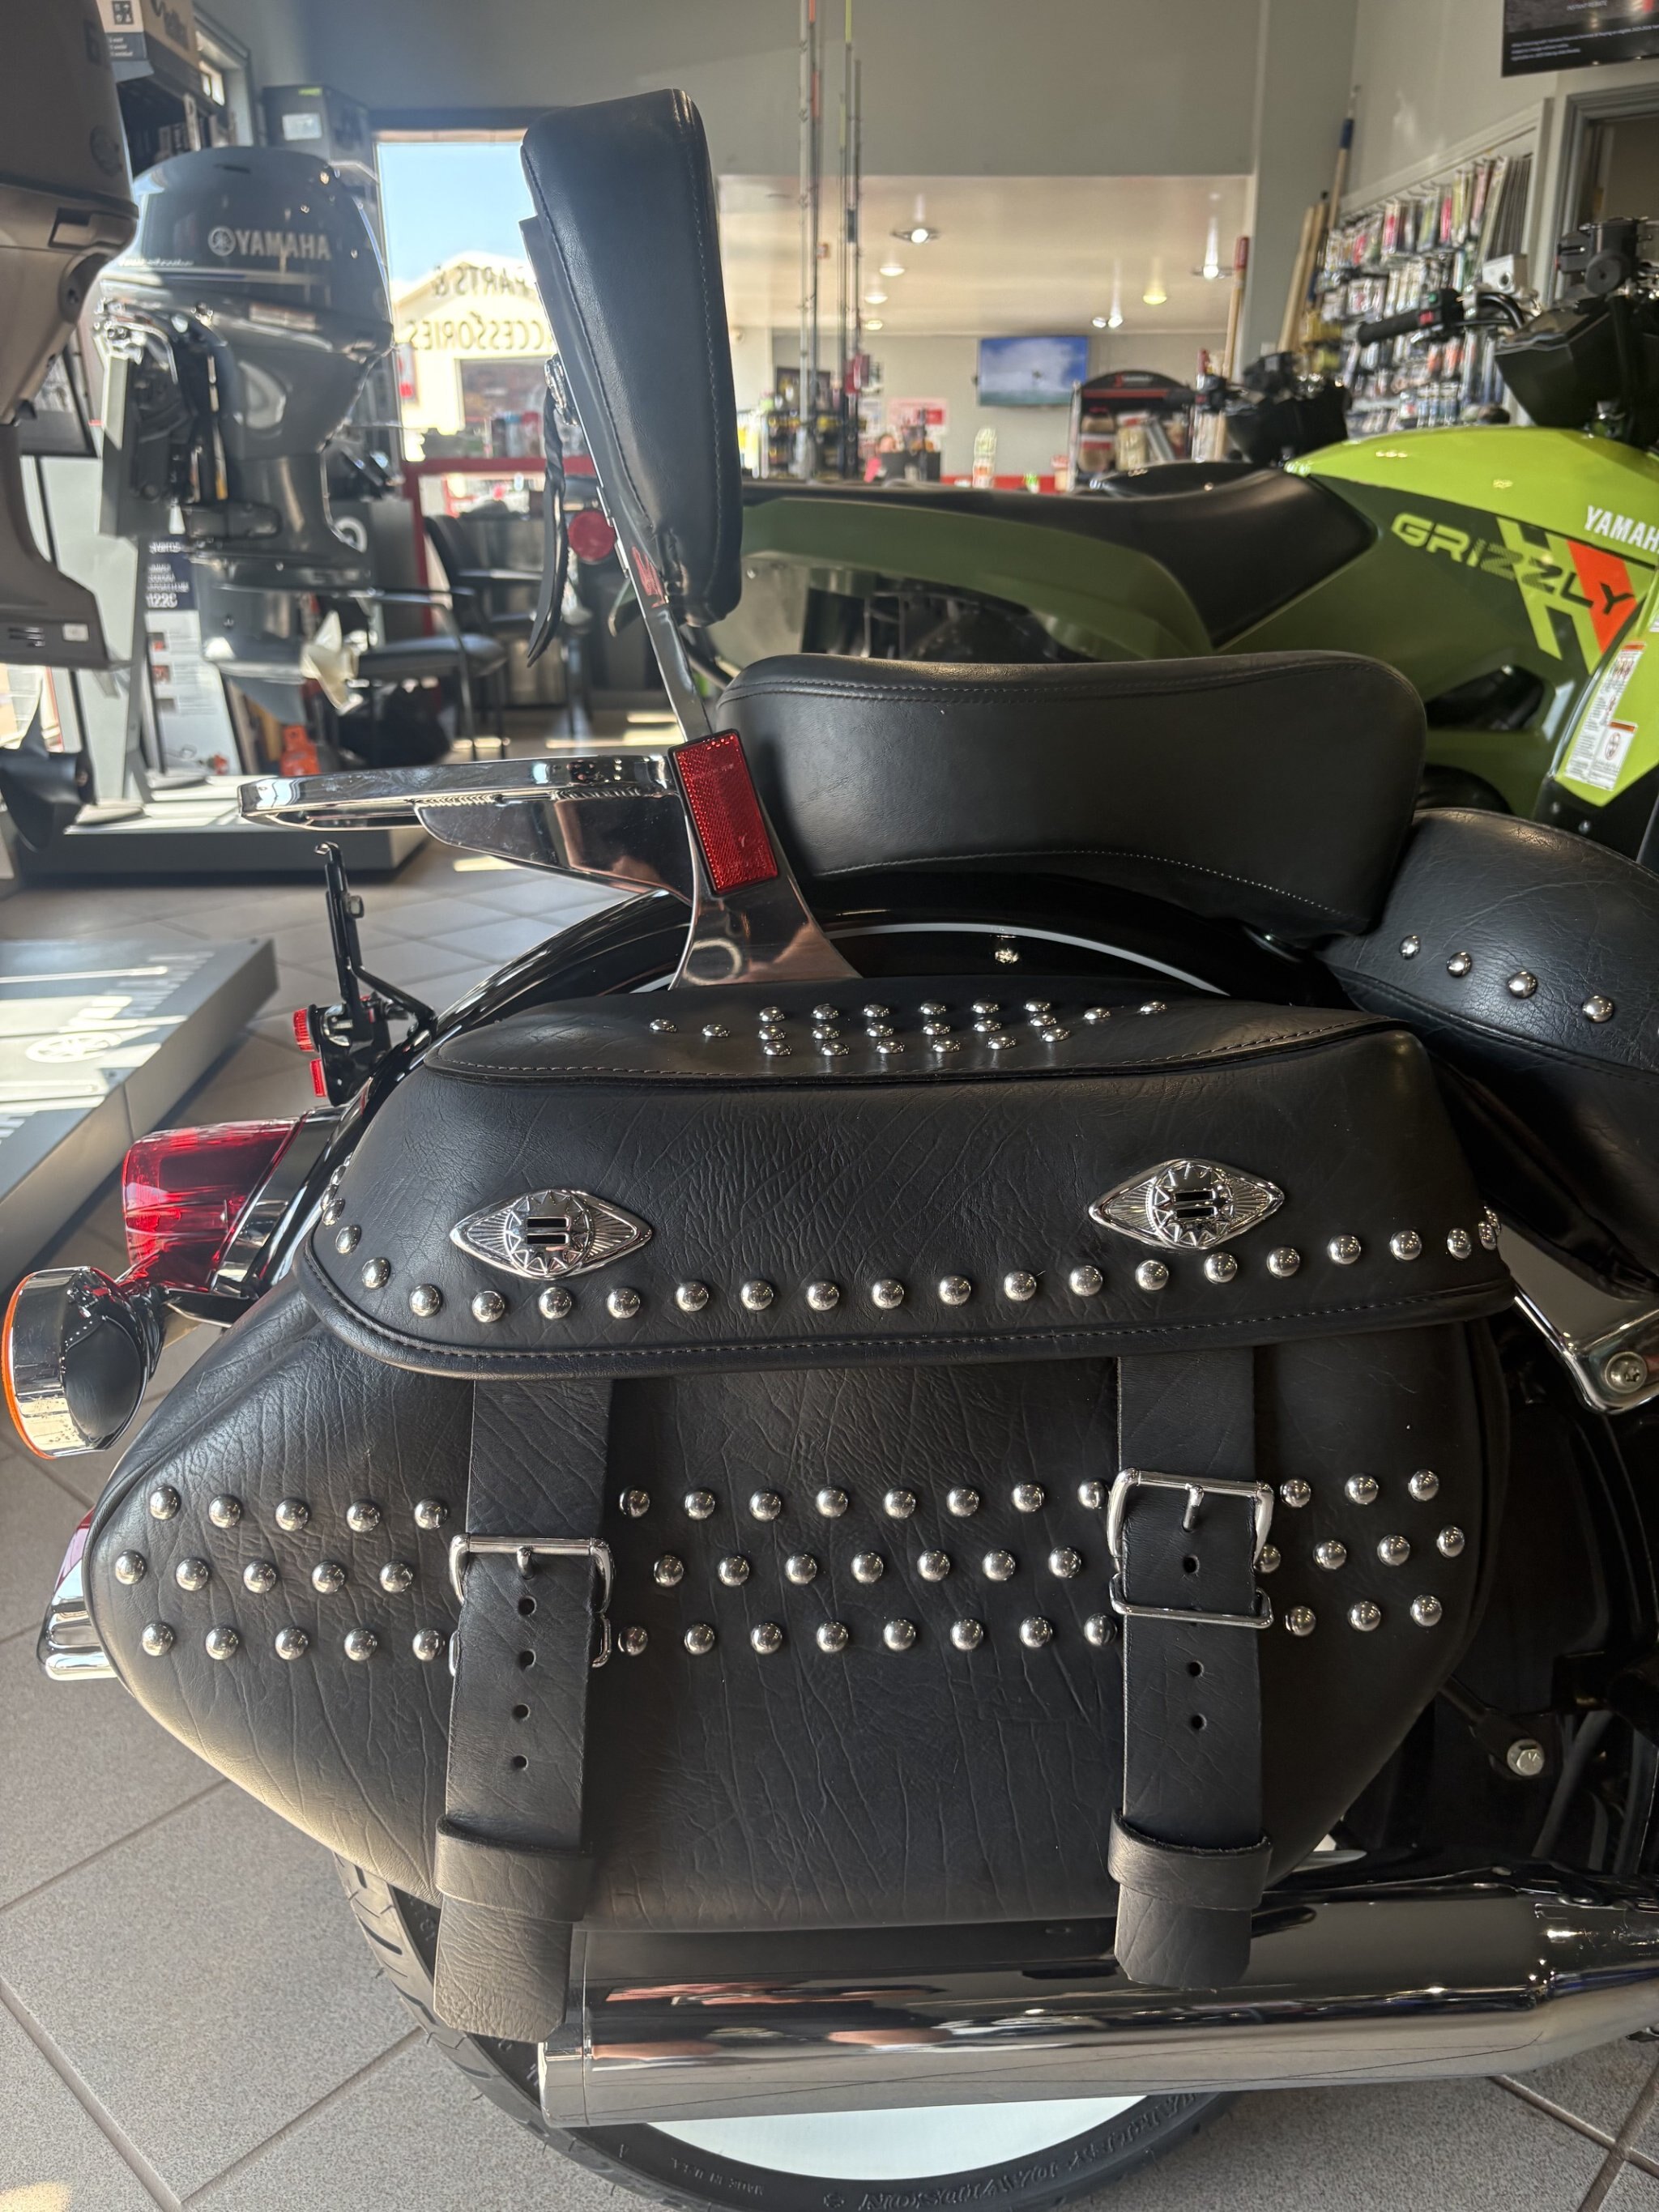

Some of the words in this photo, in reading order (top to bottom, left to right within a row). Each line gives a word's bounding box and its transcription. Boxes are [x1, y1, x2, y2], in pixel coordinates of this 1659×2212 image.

[235, 228, 332, 261] YAMAHA
[1584, 505, 1659, 555] YAMAH
[1391, 512, 1635, 616] GRIZZLY
